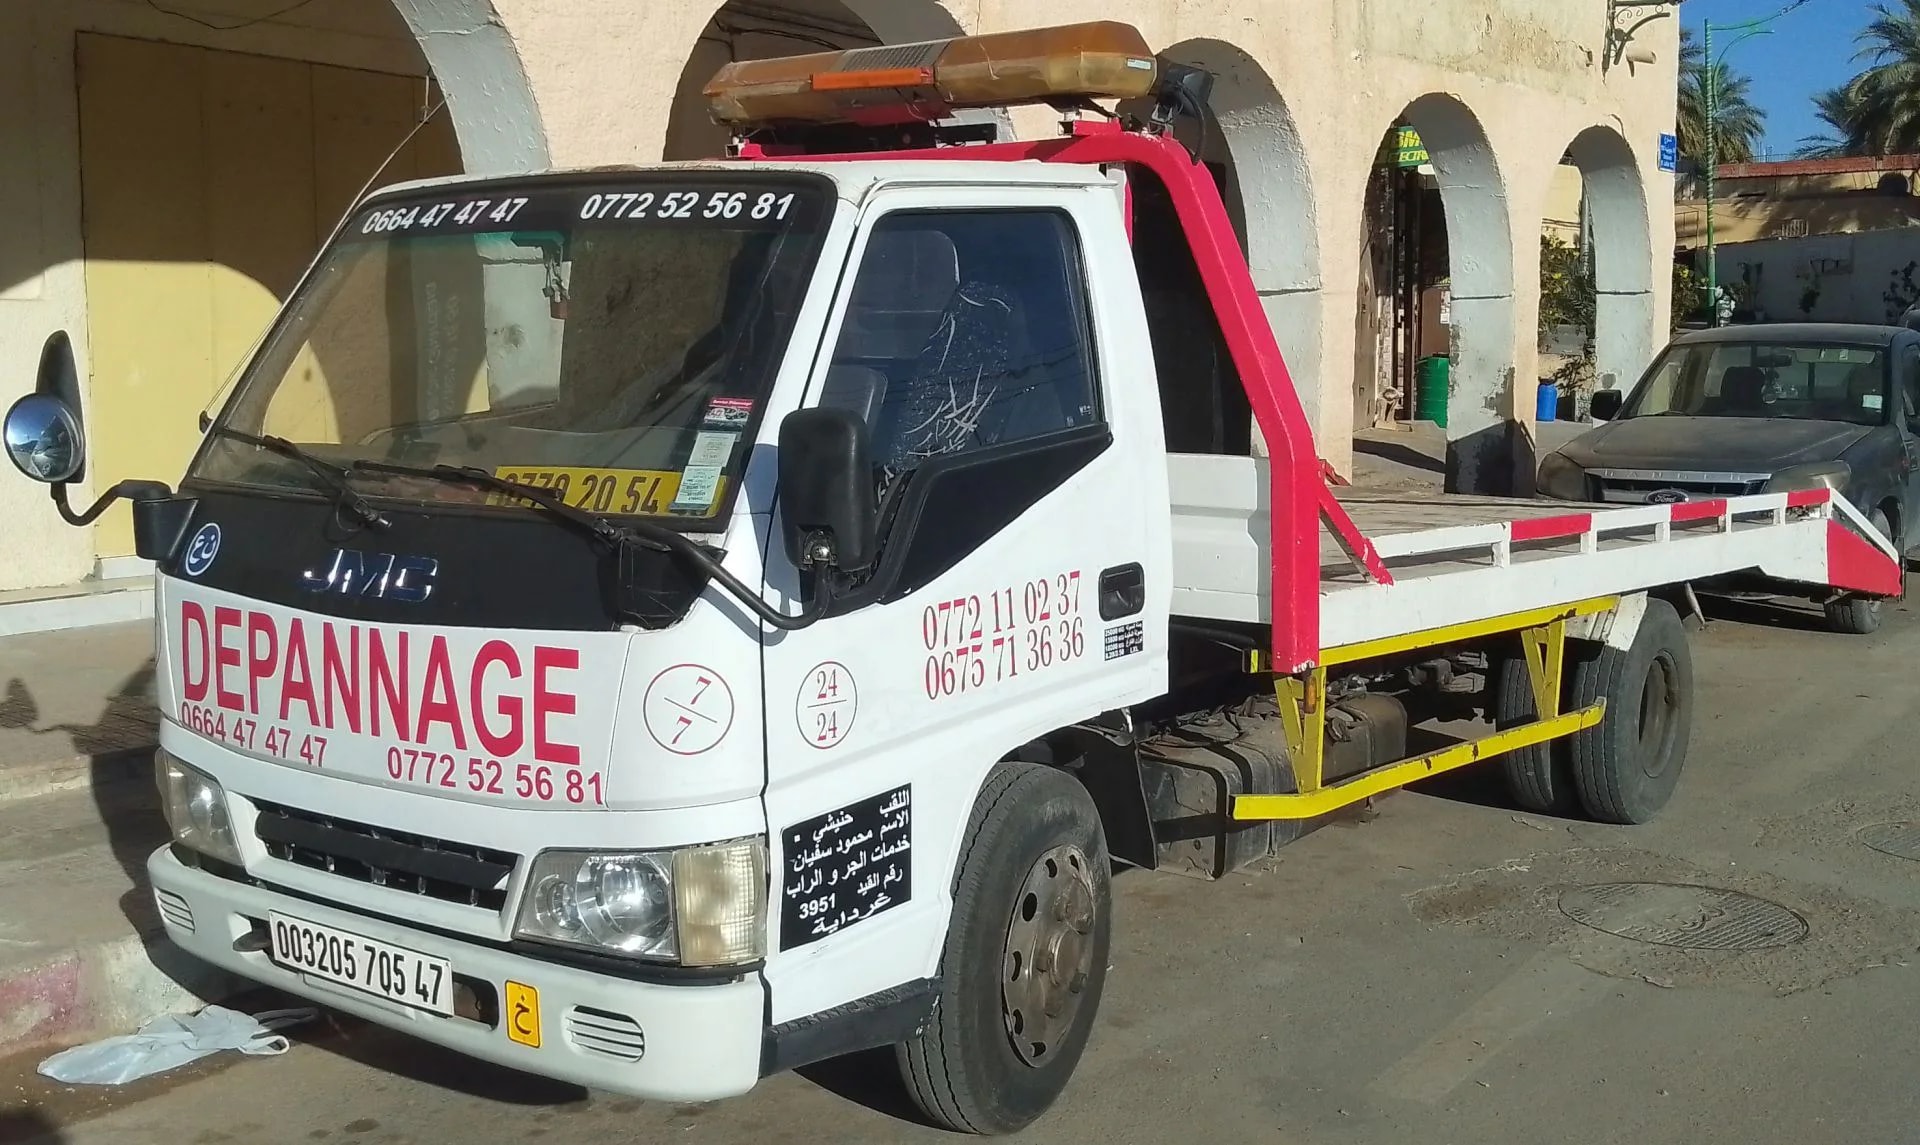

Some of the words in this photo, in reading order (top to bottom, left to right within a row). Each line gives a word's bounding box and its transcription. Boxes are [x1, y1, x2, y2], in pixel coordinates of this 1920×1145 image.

[362, 206, 421, 234] 0664
[419, 203, 456, 228] 47
[453, 200, 491, 225] 47
[489, 197, 529, 222] 47
[579, 192, 654, 220] 0772
[656, 192, 699, 218] 52
[702, 192, 747, 219] 56
[750, 193, 794, 220] 81
[575, 474, 617, 512] 20
[621, 476, 662, 514] 54
[303, 548, 439, 602] JMC
[923, 595, 983, 651] 0772
[991, 587, 1016, 633] 11
[1025, 579, 1051, 624] 02
[1057, 570, 1081, 616] 37
[925, 643, 985, 700] 0675
[992, 635, 1019, 682] 71
[1027, 625, 1052, 672] 36
[1059, 616, 1084, 662] 36
[181, 600, 581, 766] DEPANNAGE
[695, 675, 712, 705] 7
[816, 669, 837, 699] 24
[181, 702, 227, 742] 0664
[233, 717, 256, 750] 47
[265, 725, 291, 759] 47
[300, 734, 328, 768] 47
[671, 715, 693, 744] 7
[816, 710, 837, 741] 24
[387, 746, 456, 788] 0772
[468, 757, 504, 794] 52
[516, 764, 554, 801] 56
[565, 769, 603, 805] 81
[879, 789, 910, 818] اللقب
[880, 810, 909, 841] الاسم
[836, 829, 873, 854] محمود
[871, 834, 911, 862] خدمات
[793, 844, 833, 872] سفيان
[842, 851, 867, 880] الجر
[827, 868, 839, 886] و
[857, 872, 880, 896] القيد
[883, 863, 903, 890] رقم
[799, 892, 836, 919] 3951
[811, 892, 892, 934] غرداية
[276, 920, 357, 981] 003205
[364, 944, 406, 996] 705
[415, 960, 444, 1005] 47
[514, 994, 532, 1035] خ
